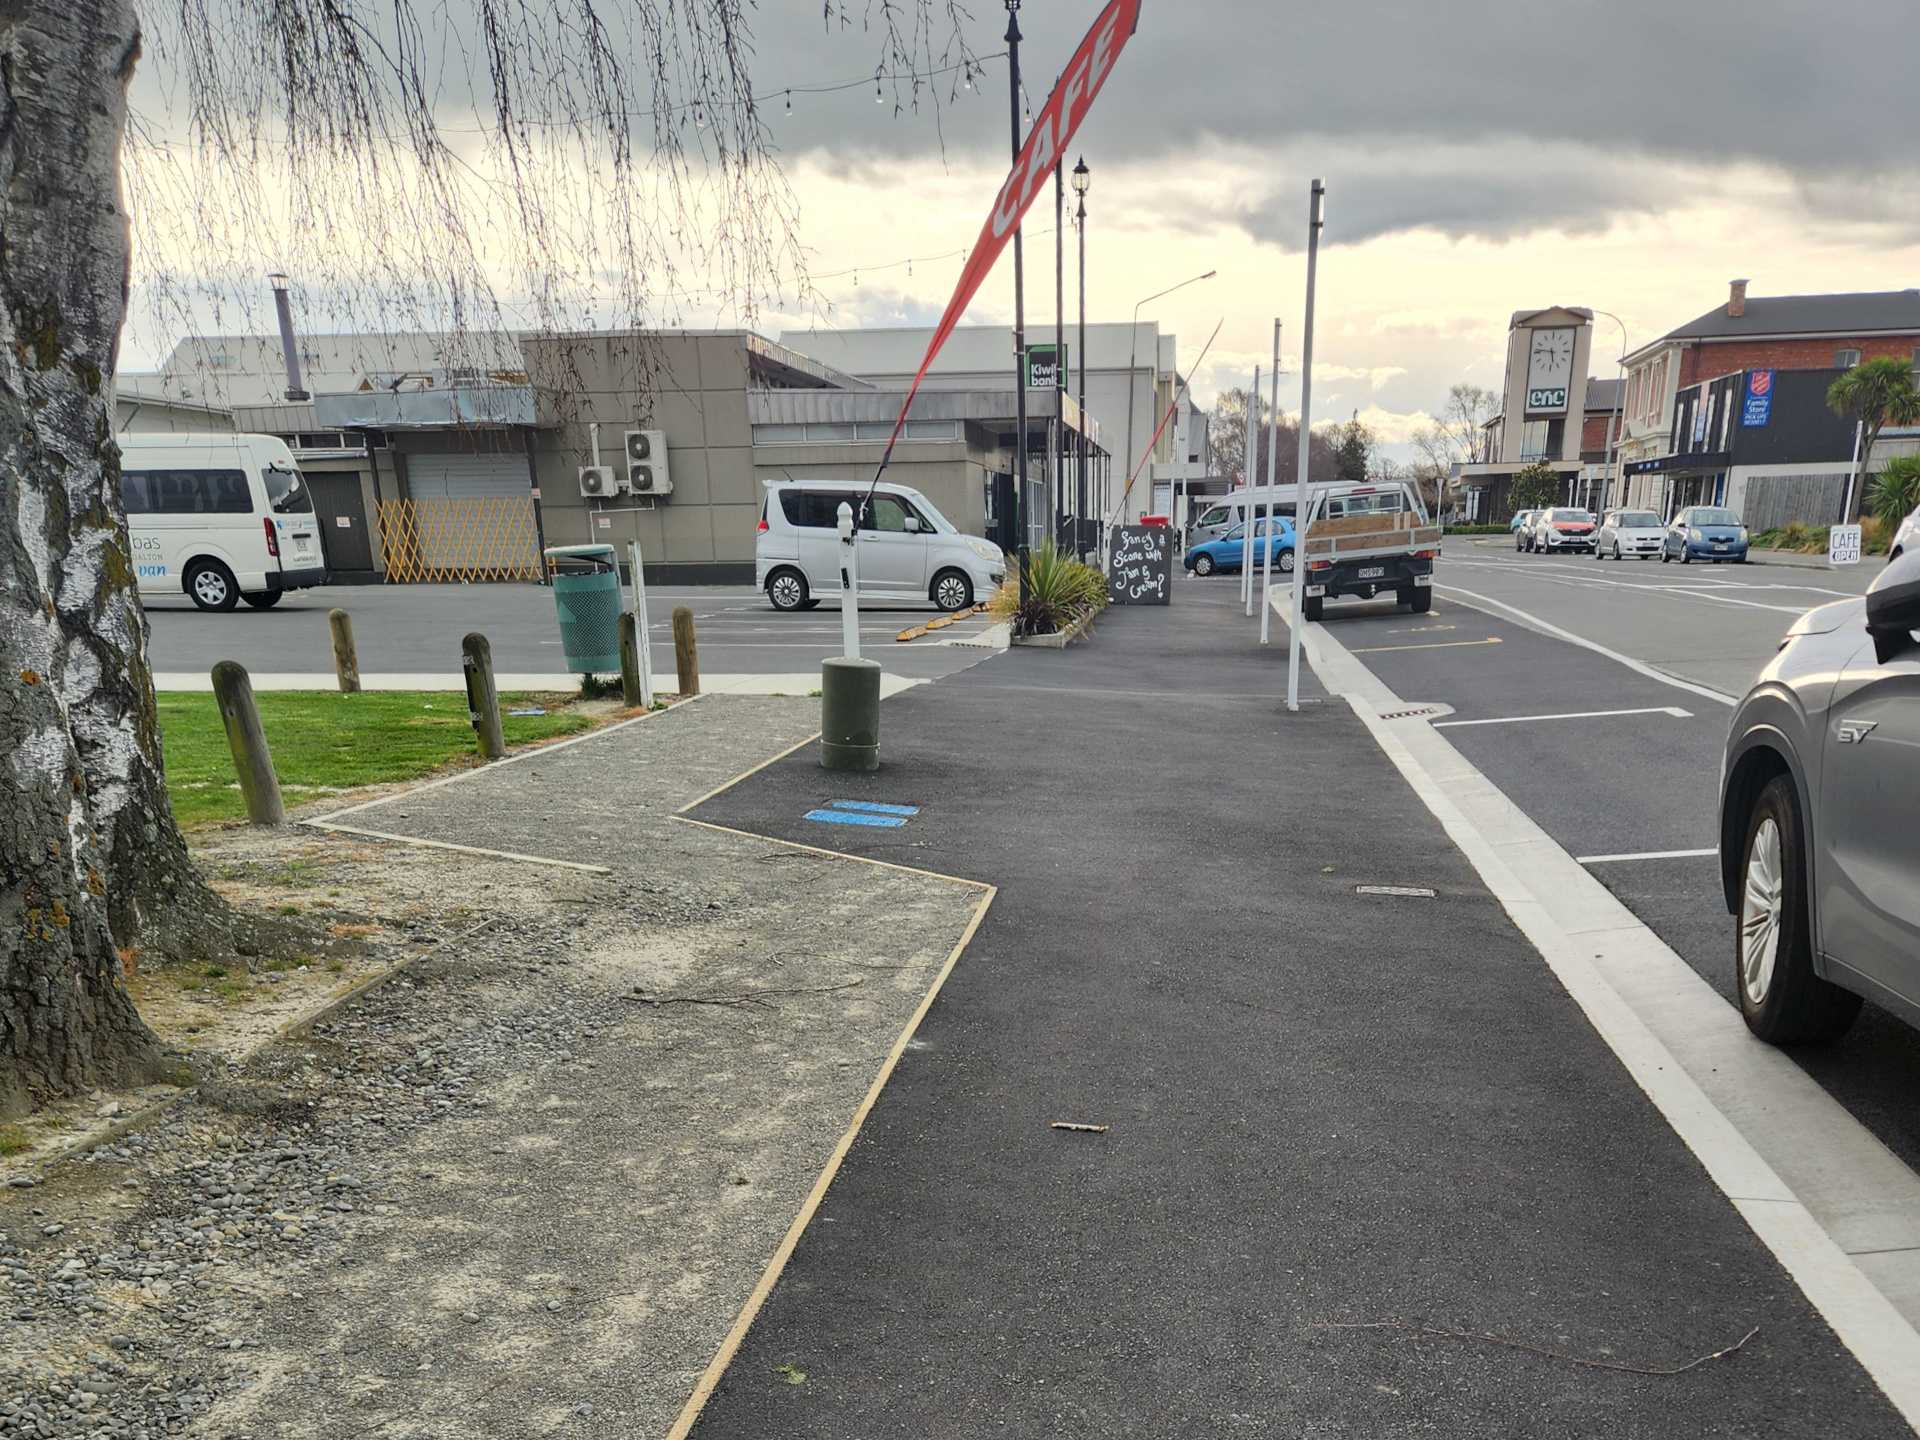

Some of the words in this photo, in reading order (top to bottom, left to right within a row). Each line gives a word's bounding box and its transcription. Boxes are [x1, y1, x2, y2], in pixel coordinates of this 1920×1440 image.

[993, 4, 1121, 239] CAFE
[1031, 363, 1054, 375] Kiwi
[1031, 374, 1058, 387] bank
[1746, 399, 1769, 408] Family
[1159, 534, 1166, 546] a
[1832, 532, 1859, 549] CAFE
[1113, 550, 1143, 567] Scone
[1145, 549, 1162, 561] with
[1835, 551, 1858, 561] OPEN
[139, 565, 167, 577] van
[1115, 566, 1140, 590] Jam
